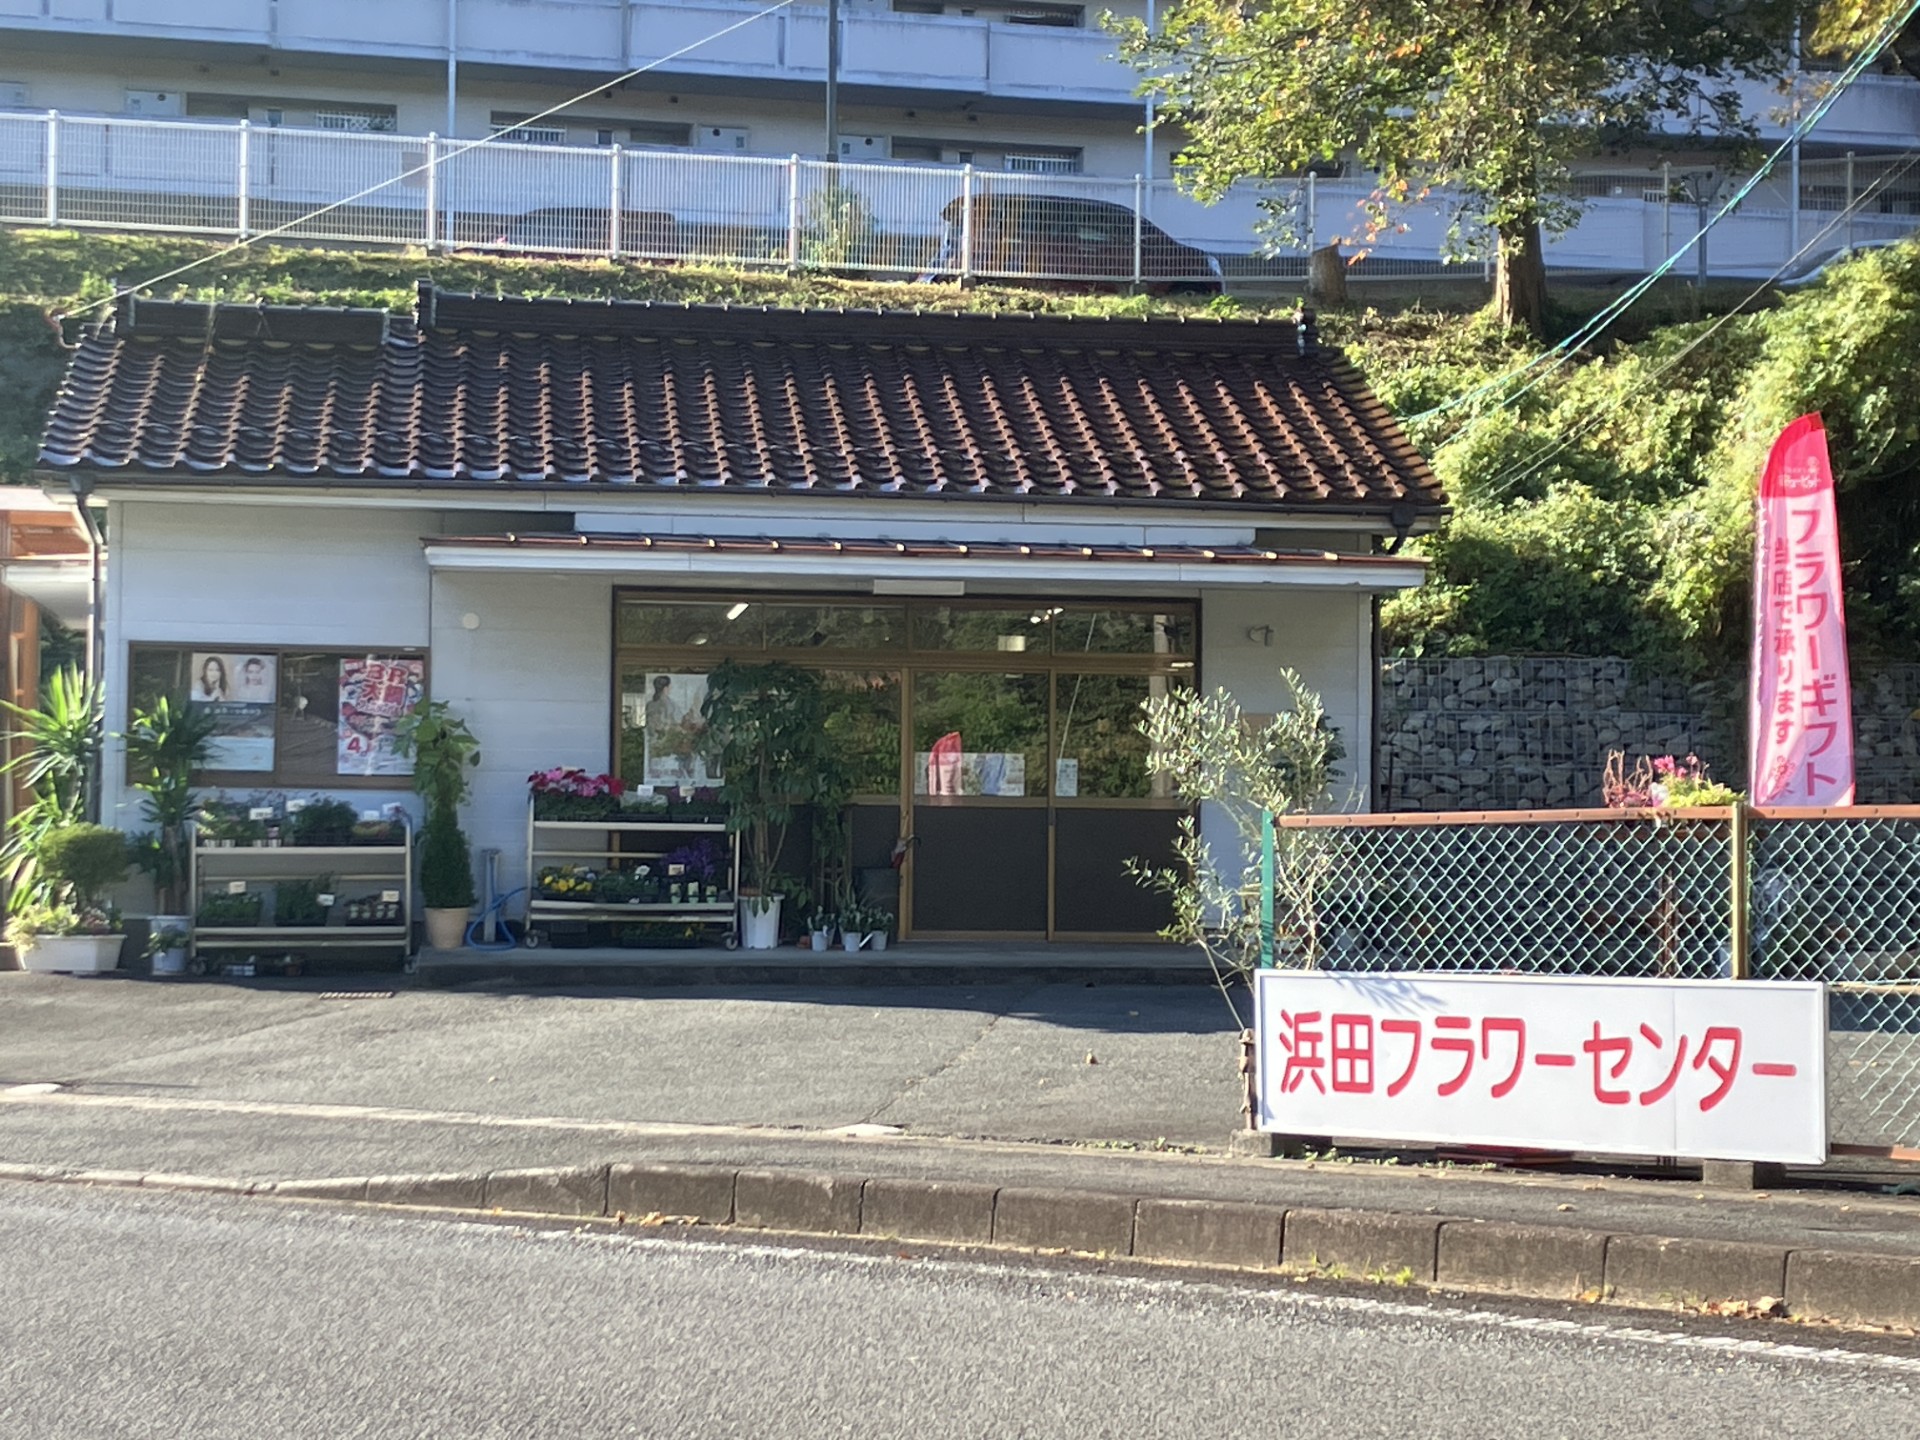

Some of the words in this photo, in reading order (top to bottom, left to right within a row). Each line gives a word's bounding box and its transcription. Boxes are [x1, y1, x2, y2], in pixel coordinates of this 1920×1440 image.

[1773, 537, 1795, 745] 当店で承ります
[1791, 509, 1837, 796] フラワーギフト
[1279, 1009, 1797, 1112] 浜田フラワーセンター
